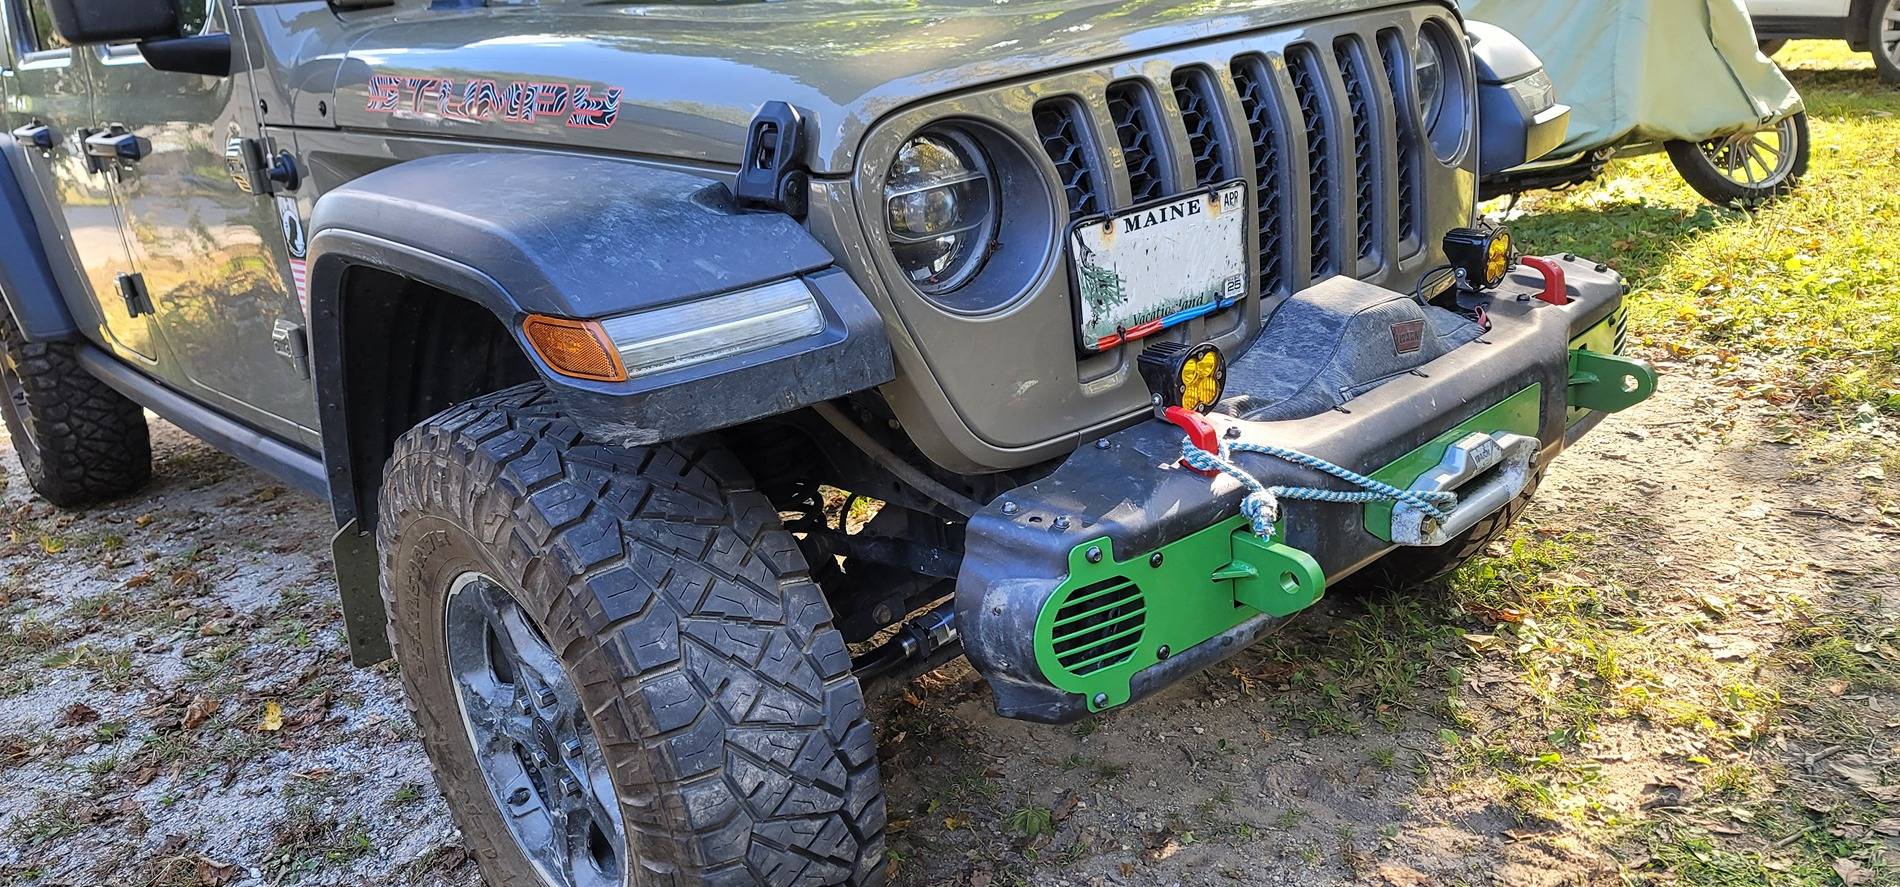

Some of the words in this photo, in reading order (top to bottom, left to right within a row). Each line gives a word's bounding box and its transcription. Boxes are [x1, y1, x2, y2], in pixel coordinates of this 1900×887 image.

[365, 74, 625, 129] STUMPY
[1224, 190, 1239, 207] APR
[1123, 199, 1200, 233] MAINE
[1227, 279, 1241, 292] 25
[1133, 292, 1204, 326] Vacatioland
